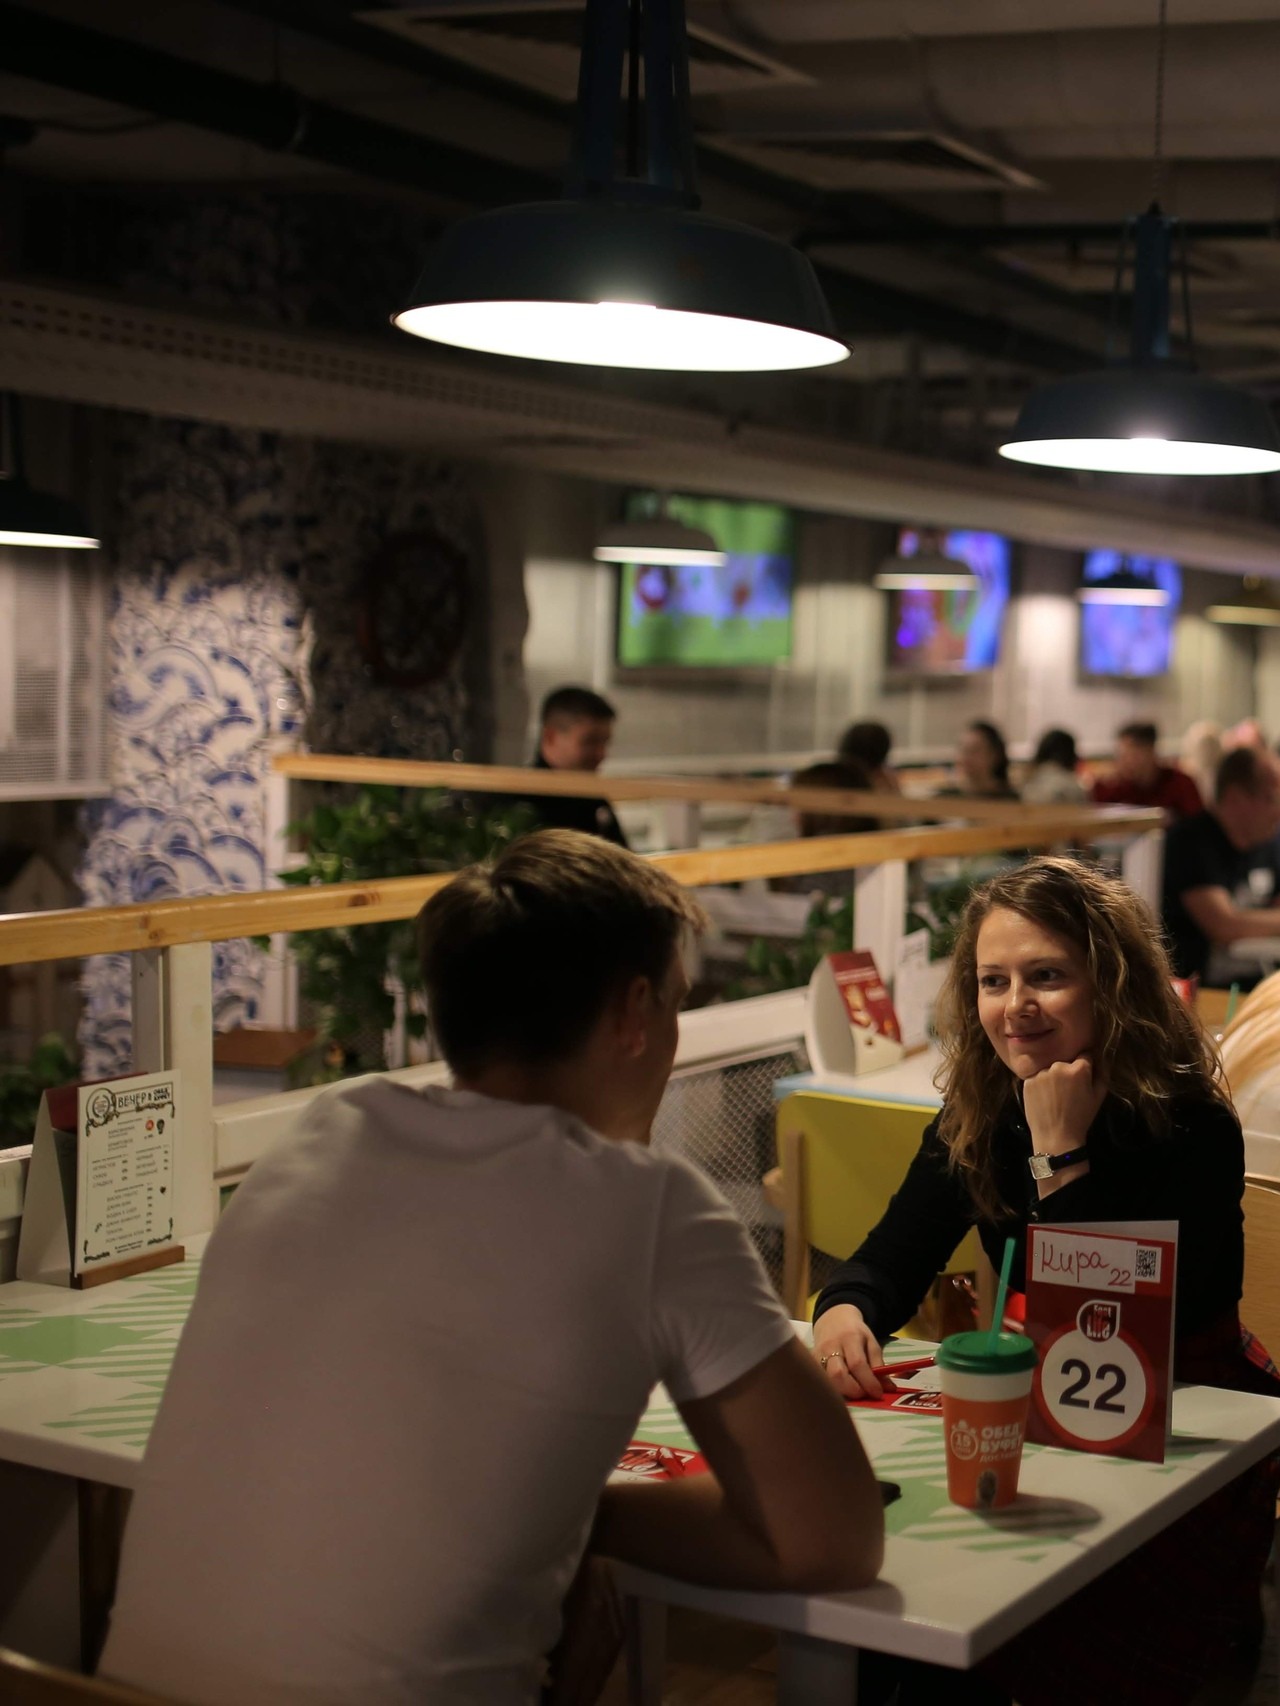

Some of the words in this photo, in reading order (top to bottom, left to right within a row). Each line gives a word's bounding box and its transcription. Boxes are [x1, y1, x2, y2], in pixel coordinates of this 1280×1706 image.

[1107, 1269, 1133, 1287] 22
[1059, 1358, 1127, 1414] 22
[981, 1422, 1021, 1440] ОБЕД
[980, 1433, 1022, 1454] БУФЕТ
